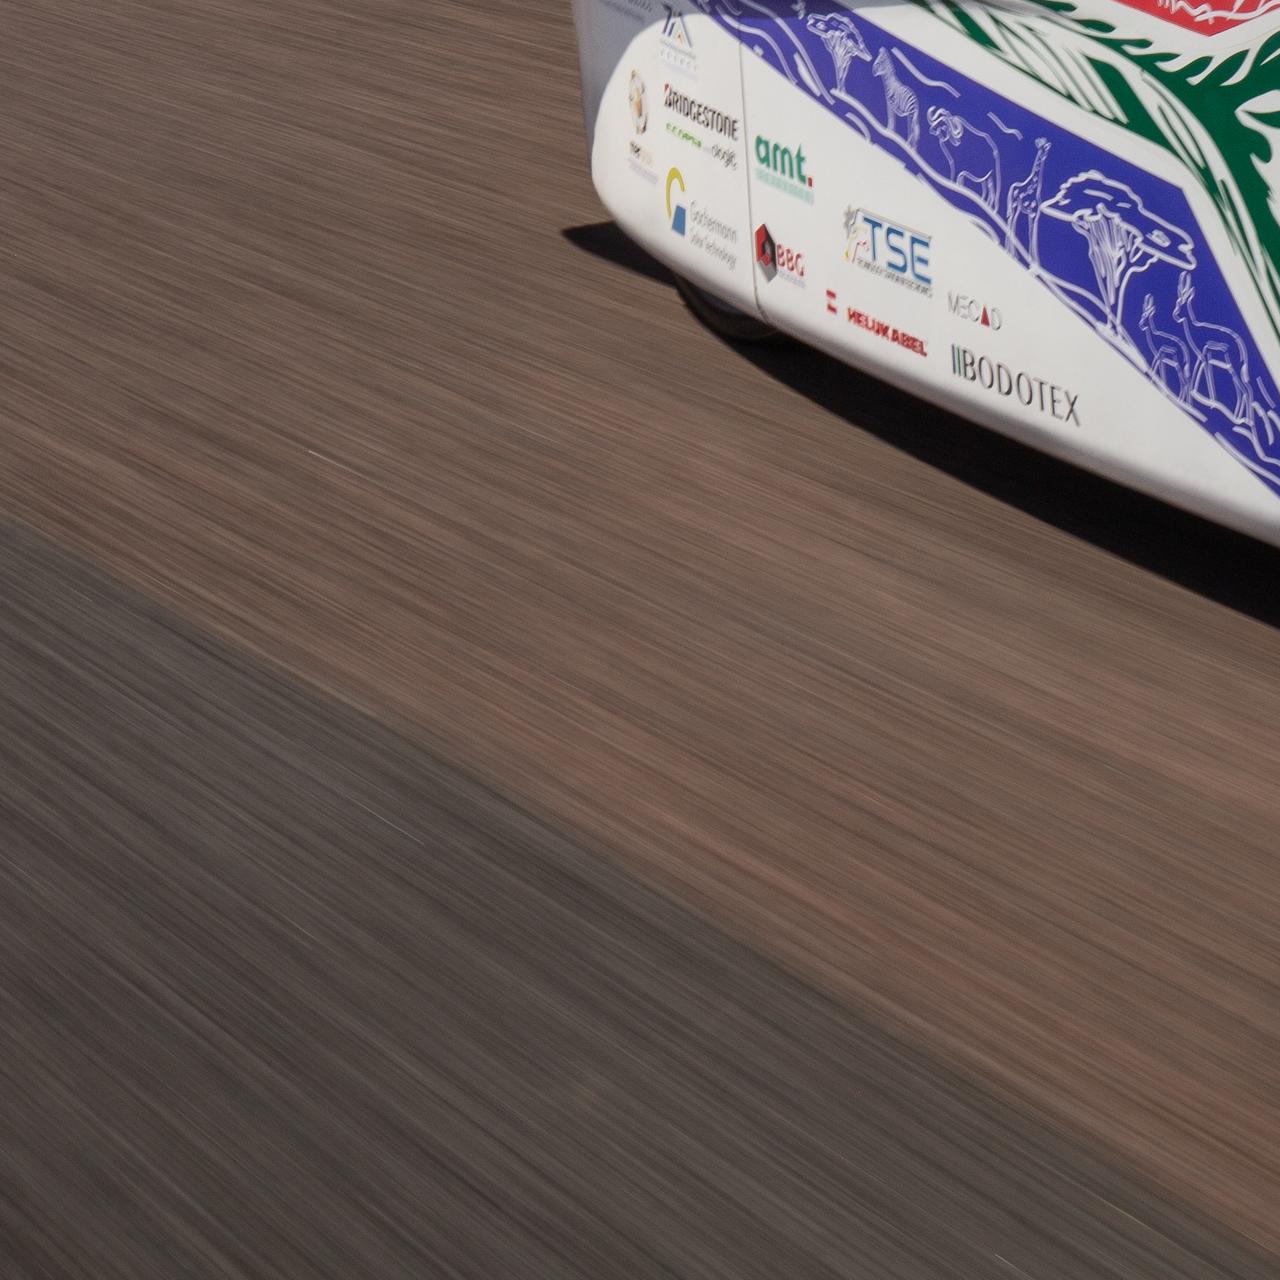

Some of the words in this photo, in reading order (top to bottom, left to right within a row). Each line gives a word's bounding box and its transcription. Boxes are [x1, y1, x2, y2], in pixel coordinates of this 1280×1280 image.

[664, 83, 739, 141] BRIDGESTONE
[776, 243, 804, 277] BBG
[863, 216, 932, 285] TSE
